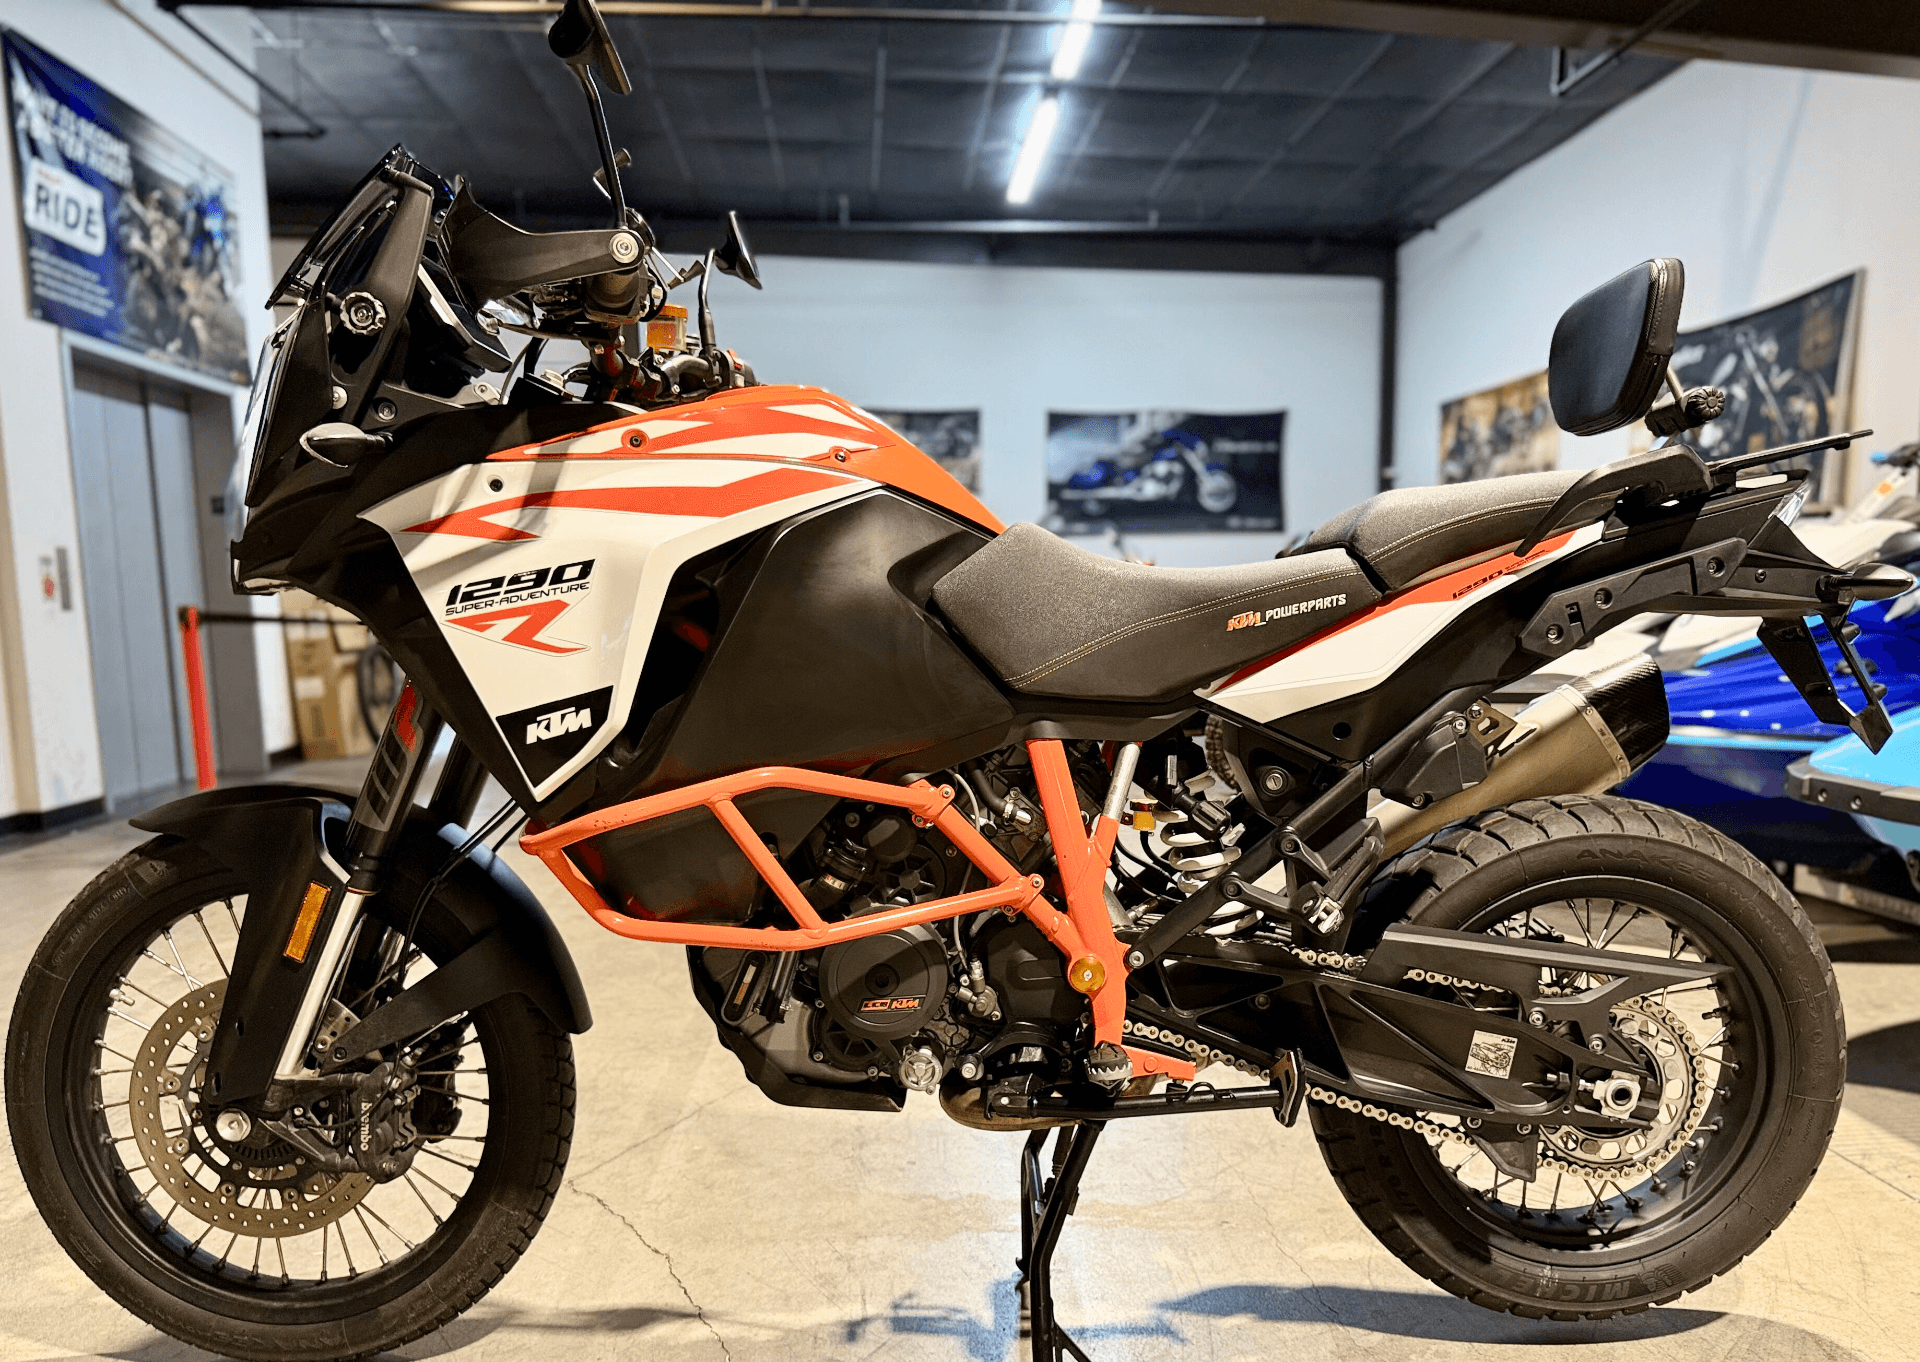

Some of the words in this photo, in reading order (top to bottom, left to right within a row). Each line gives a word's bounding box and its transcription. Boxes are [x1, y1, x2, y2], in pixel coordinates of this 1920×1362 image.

[36, 183, 98, 240] RIDE
[445, 558, 596, 607] 1290
[445, 581, 590, 616] SUPER-ADVENTURE
[1226, 611, 1261, 632] KTM
[1265, 593, 1347, 622] POWERPARTS
[526, 706, 592, 745] KTM
[891, 998, 920, 1010] KTM
